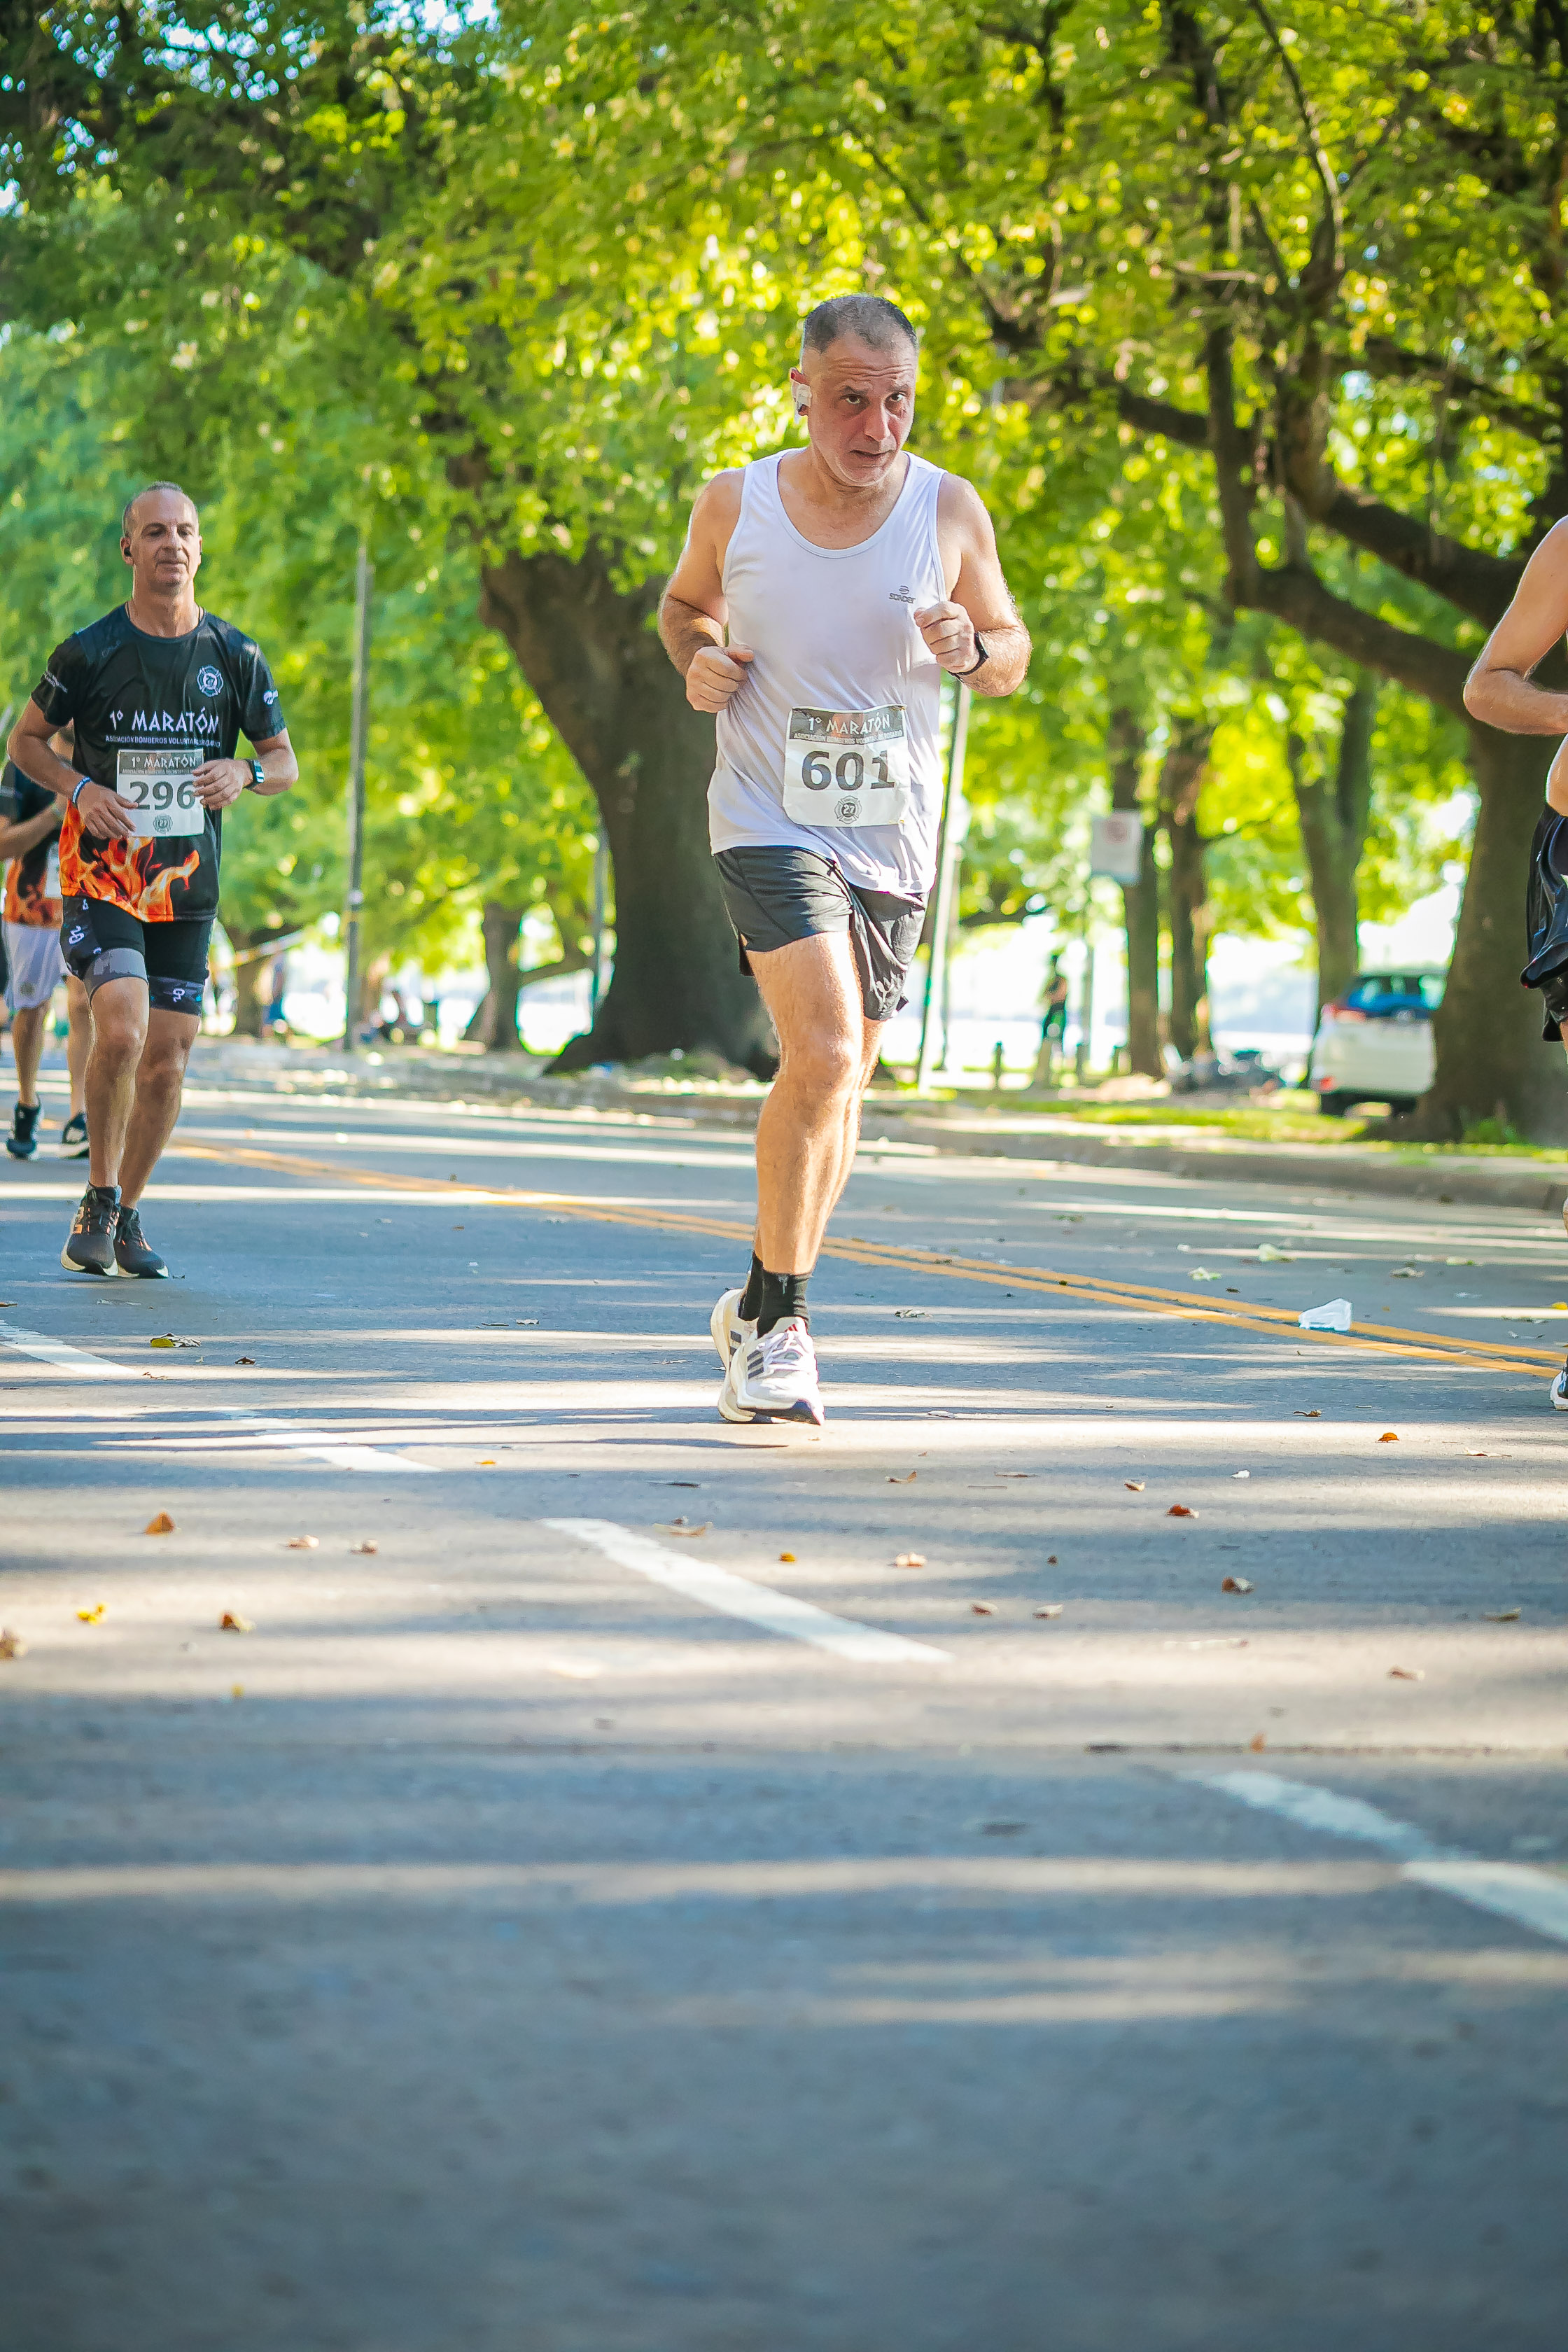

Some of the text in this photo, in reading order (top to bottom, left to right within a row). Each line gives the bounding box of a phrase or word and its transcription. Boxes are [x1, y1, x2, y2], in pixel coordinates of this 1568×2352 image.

[132, 706, 218, 734] MARATÓN
[826, 711, 890, 735] MARATÓN
[134, 736, 167, 745] BOMBEROS
[144, 753, 196, 769] MARATÓN
[802, 750, 895, 791] 601
[130, 780, 196, 811] 296
[842, 804, 855, 814] 27
